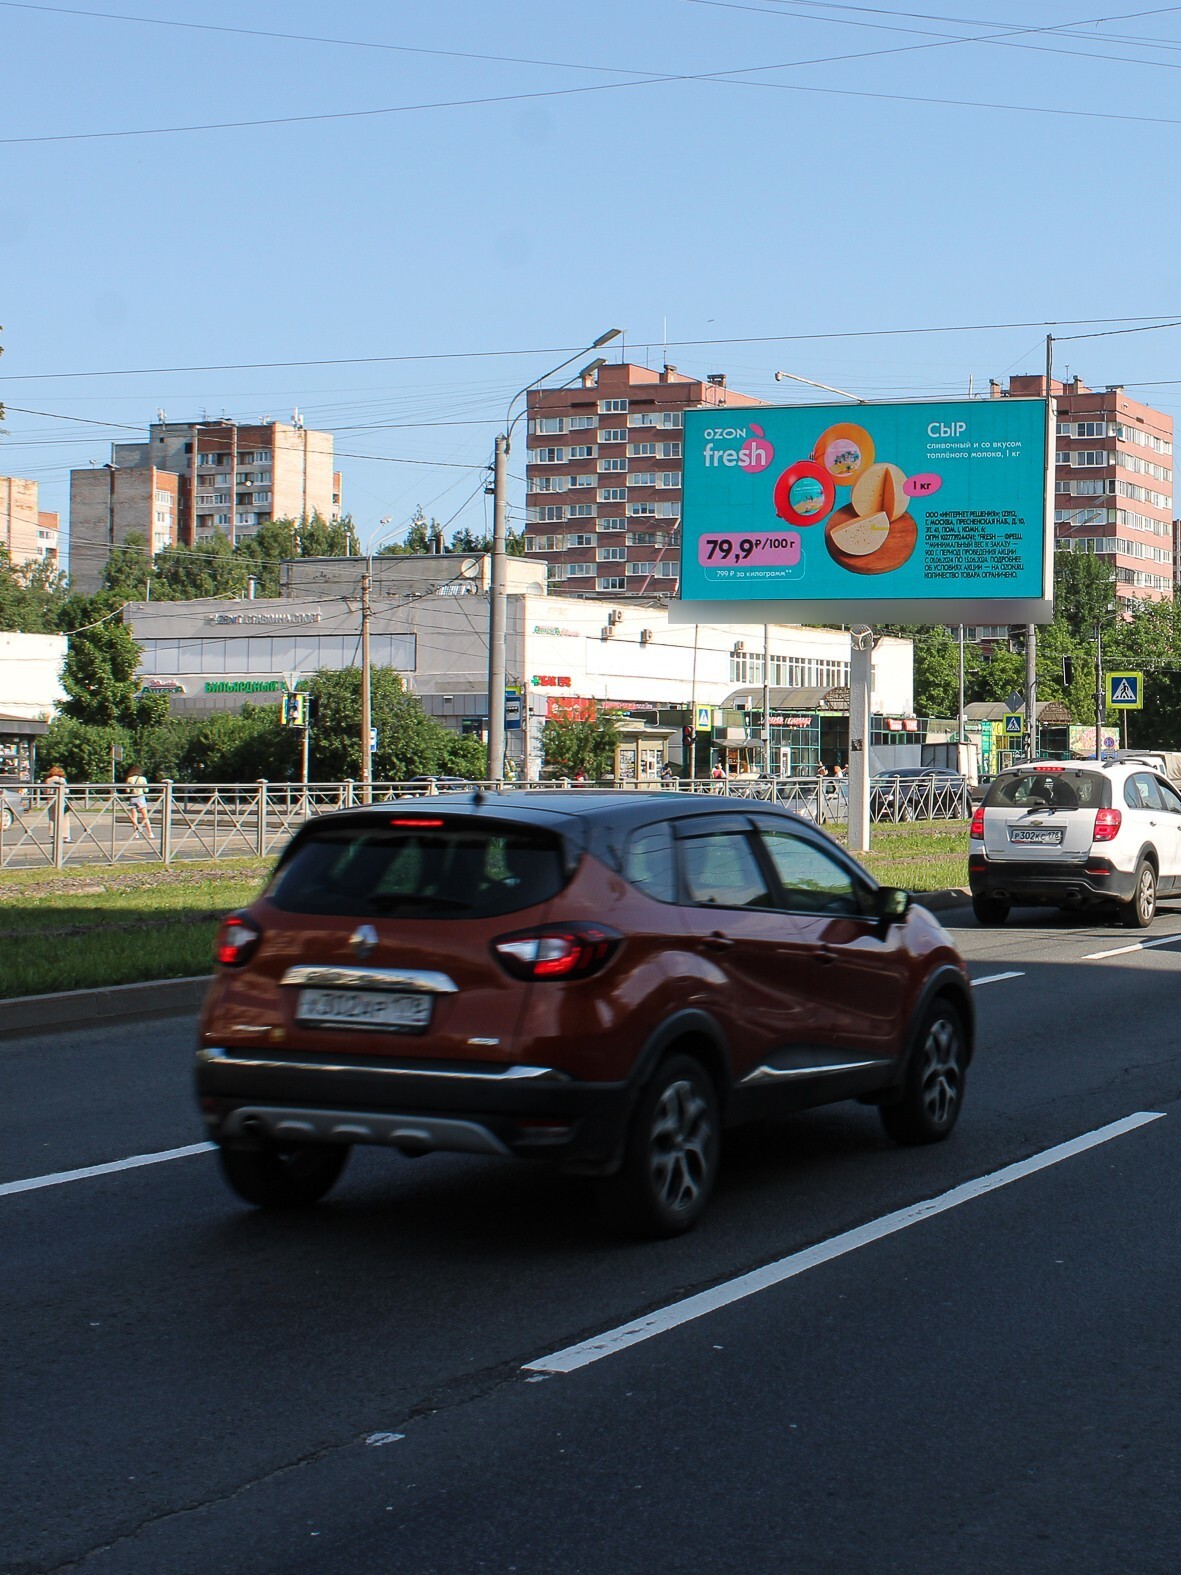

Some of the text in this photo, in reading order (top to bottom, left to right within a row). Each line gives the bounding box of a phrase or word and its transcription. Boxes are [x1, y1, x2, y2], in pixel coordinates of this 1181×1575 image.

[927, 422, 966, 438] СЫР
[992, 441, 1022, 449] вкусом
[703, 442, 766, 467] fresh
[926, 451, 968, 459] топлёного
[204, 680, 277, 693] БИЛЬЯРДНЫЙ
